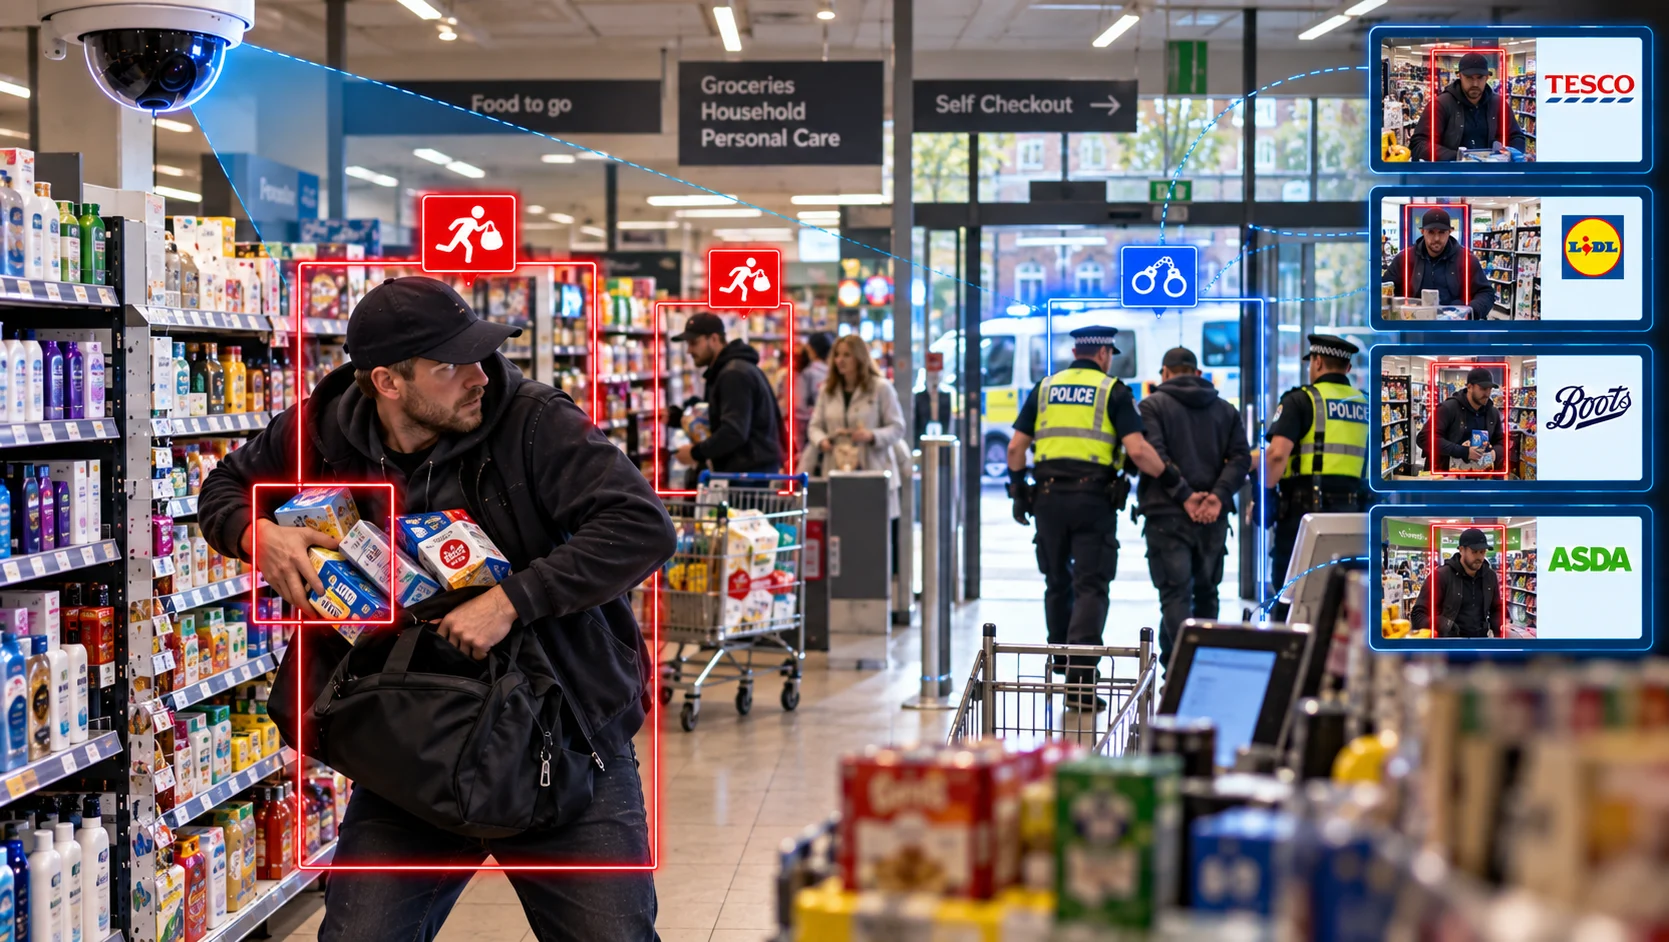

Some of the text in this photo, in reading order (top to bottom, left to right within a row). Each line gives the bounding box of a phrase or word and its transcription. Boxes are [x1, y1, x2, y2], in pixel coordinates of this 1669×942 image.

[701, 75, 796, 95] Groceries
[471, 93, 573, 118] Food to go
[701, 101, 806, 121] Household
[935, 94, 1074, 114] Self Checkout
[701, 127, 841, 148] Personal Care
[1049, 386, 1095, 404] POLICE
